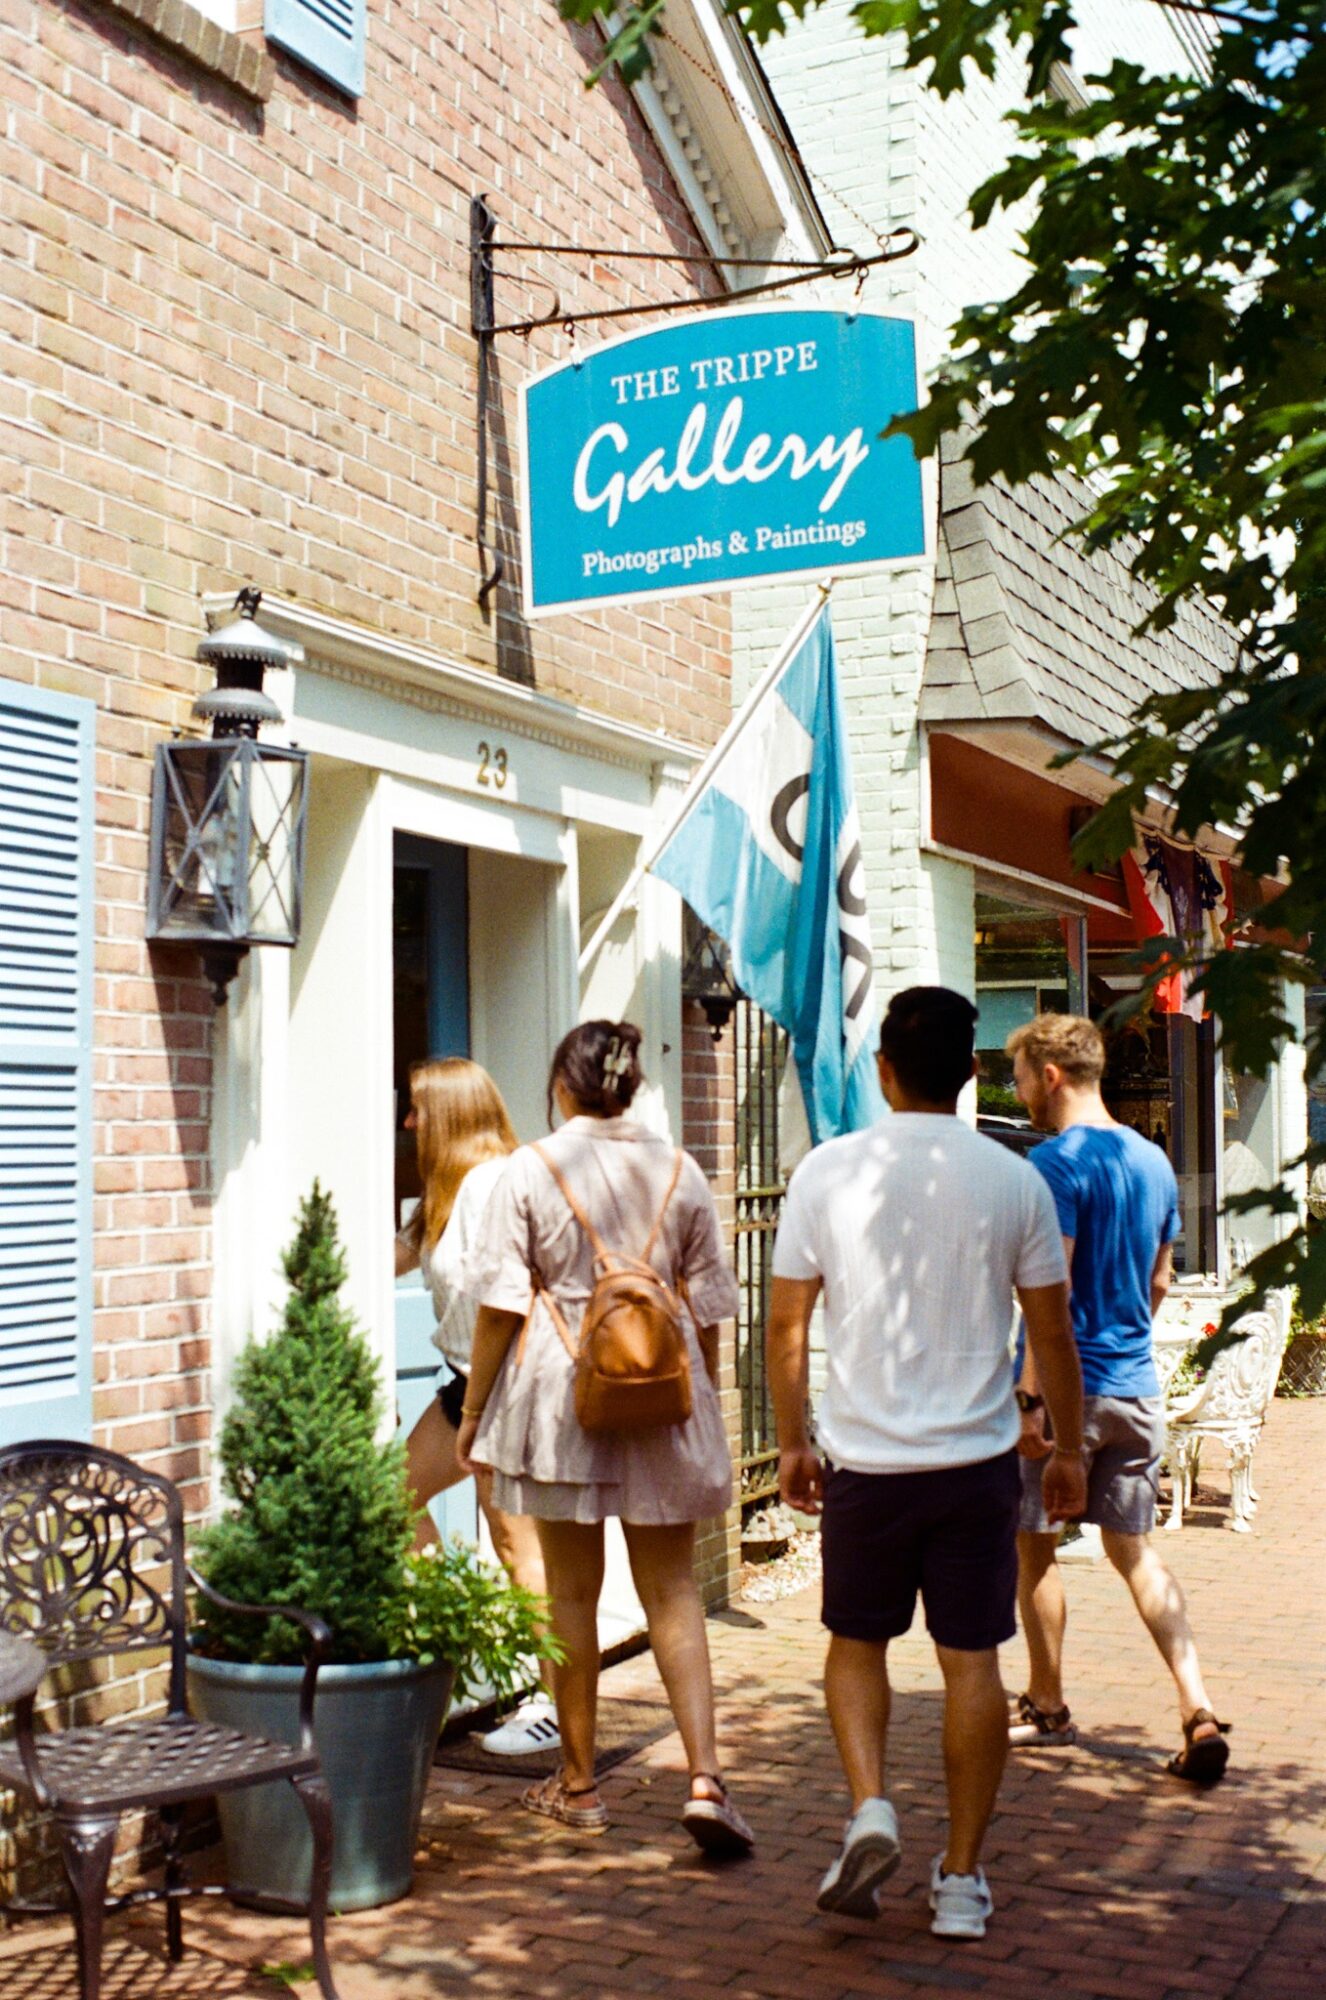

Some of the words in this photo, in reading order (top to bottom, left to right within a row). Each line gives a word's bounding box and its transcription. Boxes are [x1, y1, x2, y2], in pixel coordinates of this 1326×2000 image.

[610, 365, 680, 404] THE
[690, 341, 818, 390] TRIPPE
[573, 395, 870, 528] Gallery
[582, 535, 723, 577] Photographs
[728, 530, 749, 555] &
[755, 519, 866, 552] Paintings
[477, 741, 508, 790] 23
